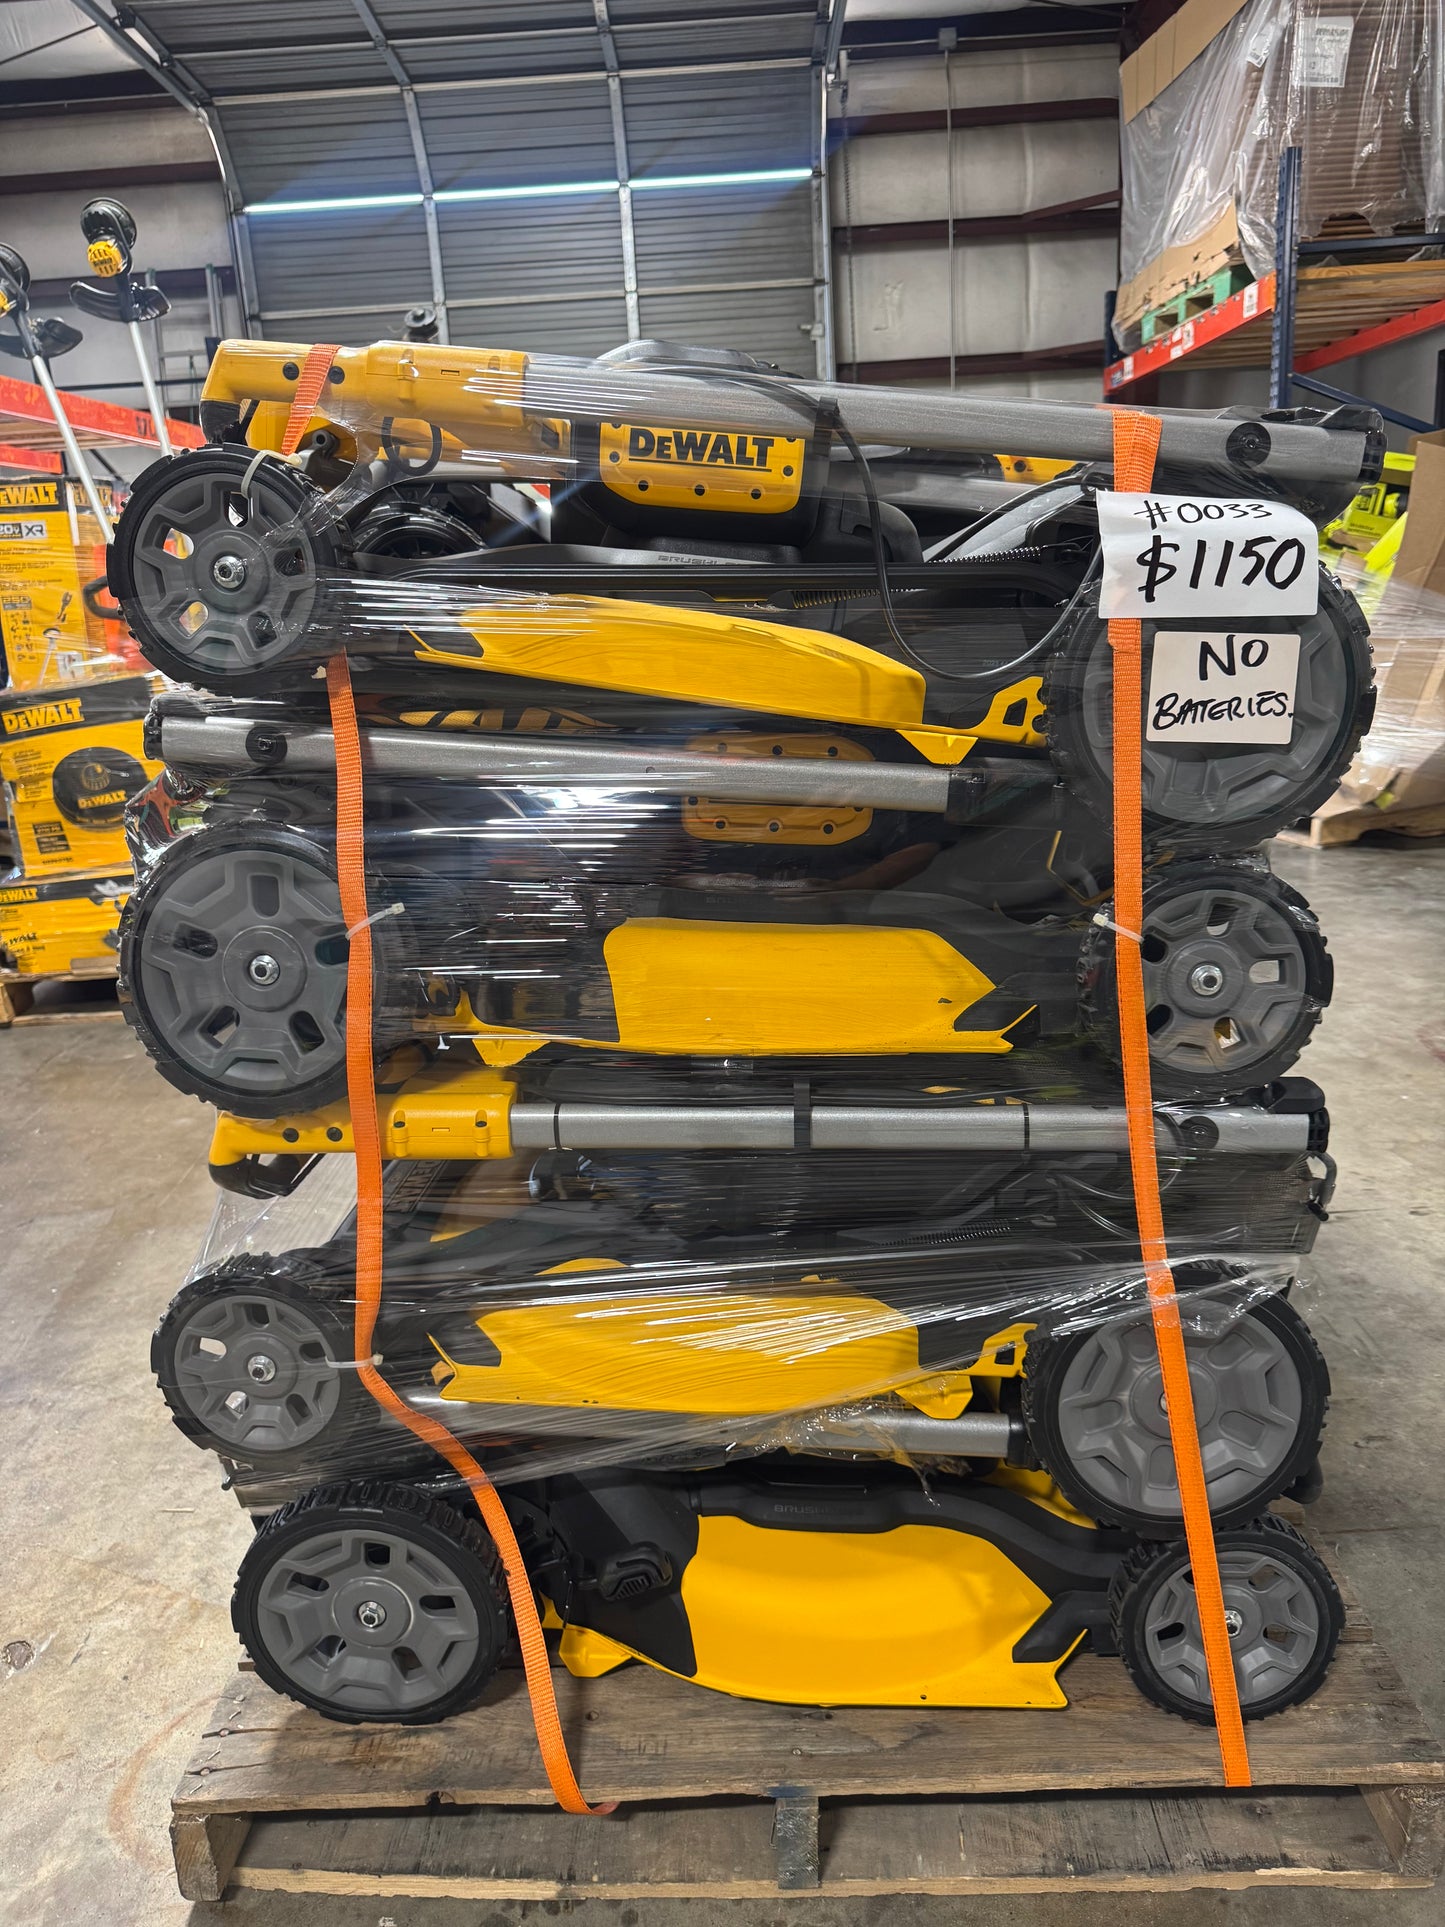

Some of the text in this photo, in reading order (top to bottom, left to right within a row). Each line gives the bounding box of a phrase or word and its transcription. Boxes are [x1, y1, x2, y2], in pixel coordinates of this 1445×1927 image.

[629, 427, 774, 468] DEWALT
[0, 485, 57, 505] EWALT
[24, 524, 44, 536] XR
[1134, 500, 1272, 530] #0033
[1136, 534, 1305, 603] $1150
[1199, 634, 1269, 681] NO
[3, 700, 82, 733] DEWALT
